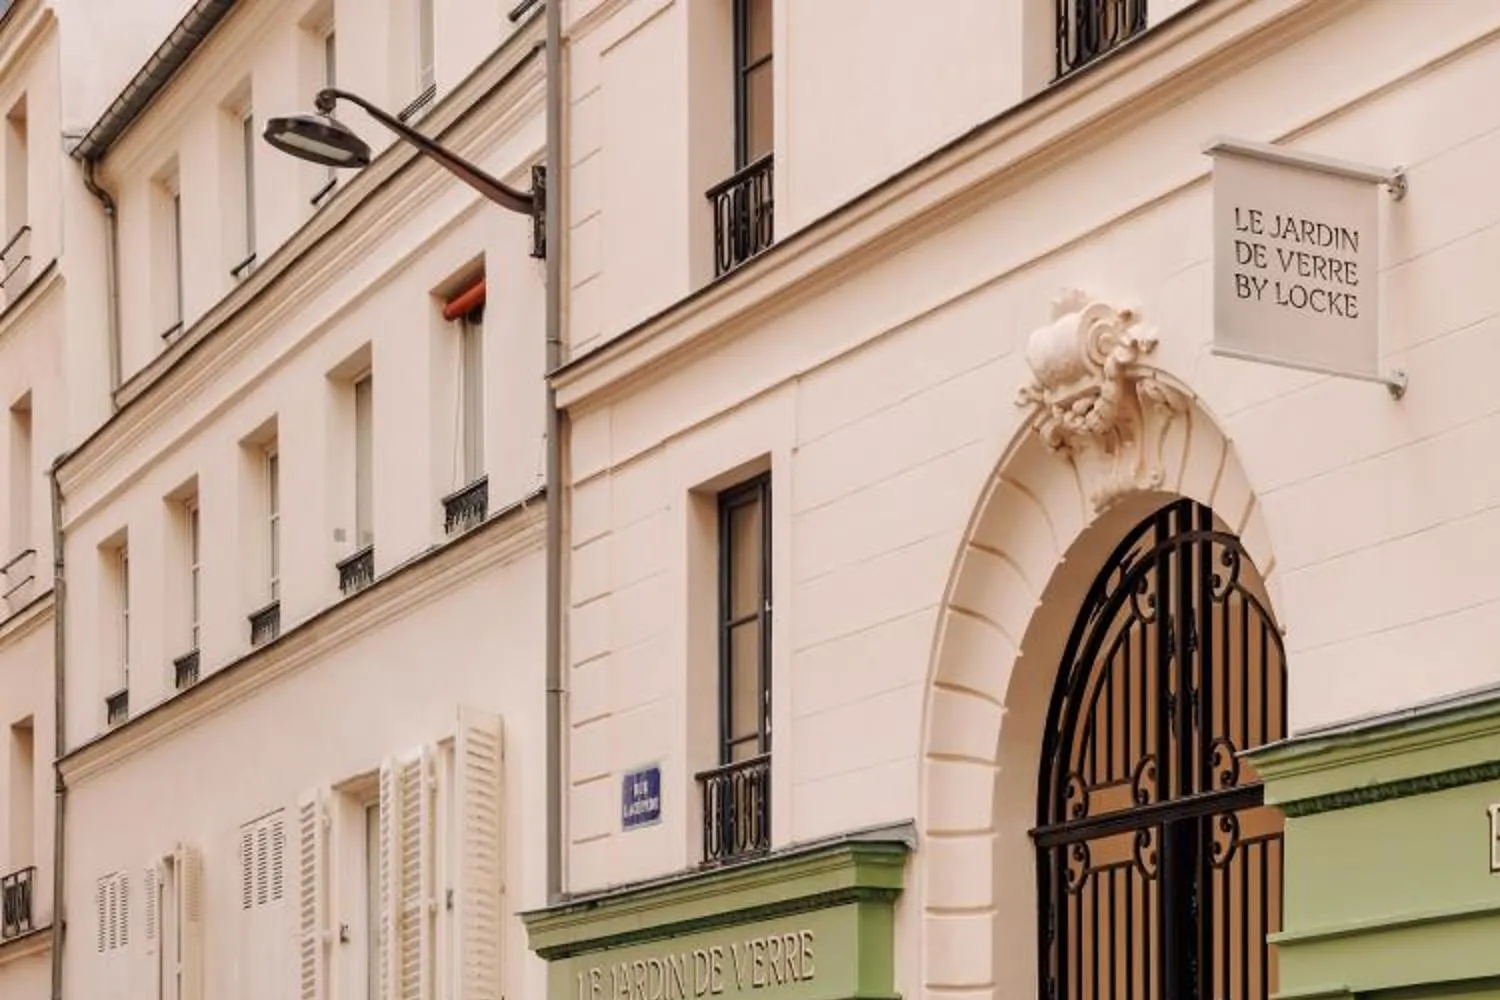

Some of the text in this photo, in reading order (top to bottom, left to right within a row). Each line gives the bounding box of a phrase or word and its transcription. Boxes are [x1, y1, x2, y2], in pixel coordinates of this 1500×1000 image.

[1235, 207, 1360, 253] LE JARDIN
[1234, 239, 1359, 287] DE VERRE
[1234, 273, 1359, 319] BY LOCKE
[692, 945, 725, 998] DE
[730, 928, 816, 991] VERRE
